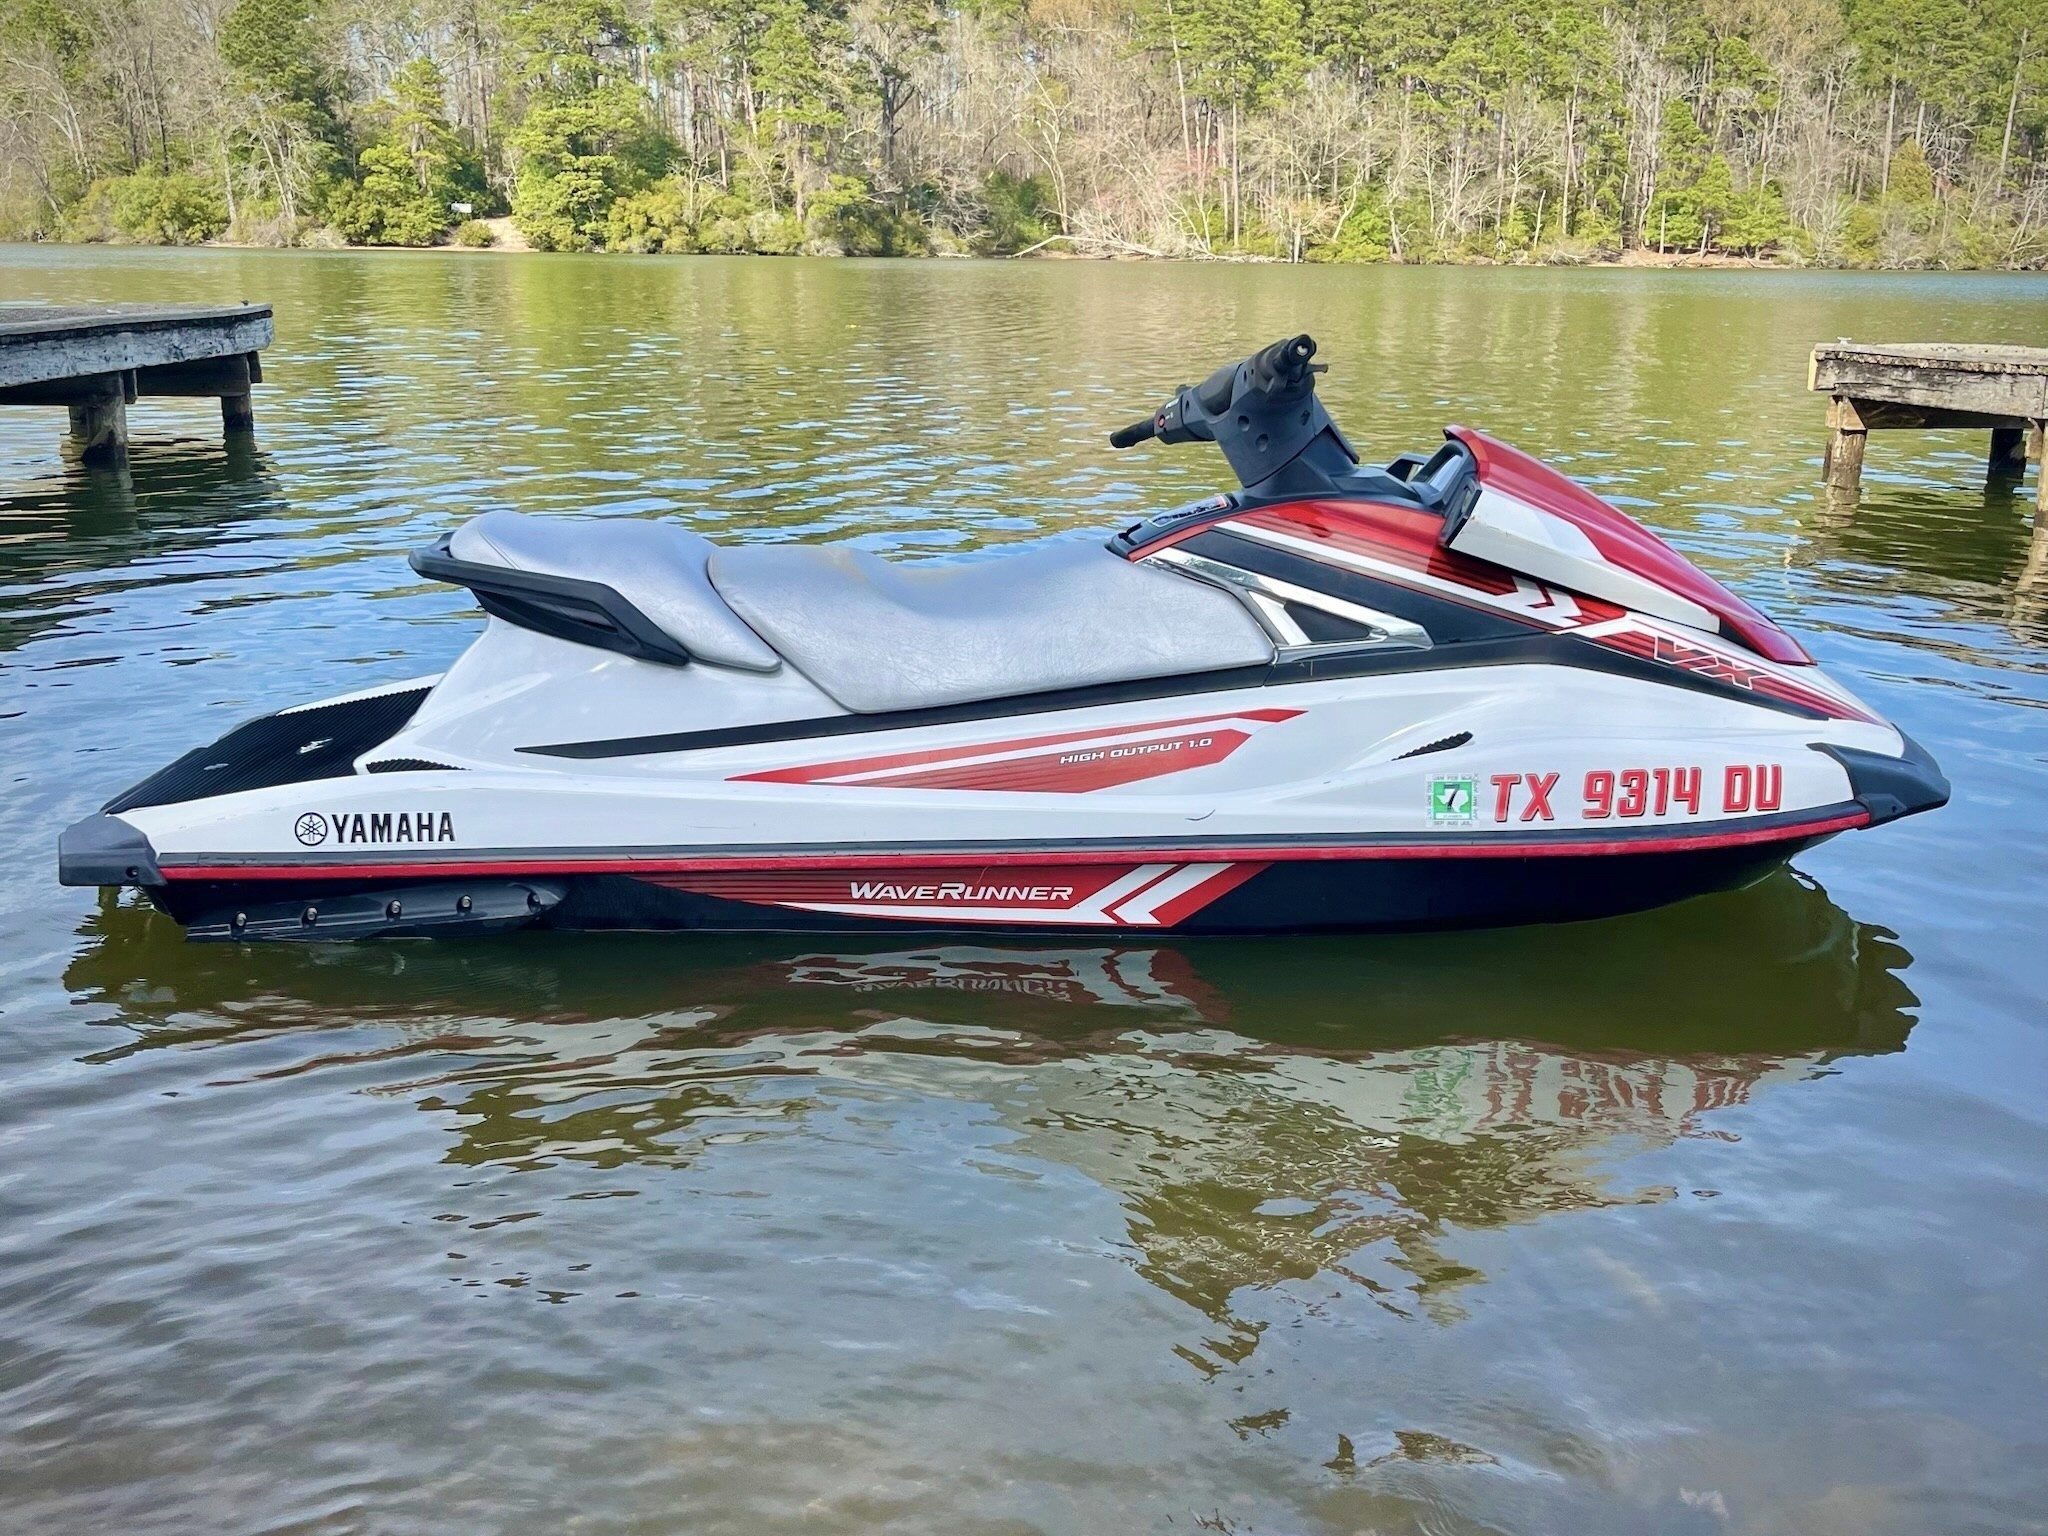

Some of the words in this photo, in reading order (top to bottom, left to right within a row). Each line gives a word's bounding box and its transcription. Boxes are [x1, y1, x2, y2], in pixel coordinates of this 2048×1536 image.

[1653, 635, 1770, 690] VX
[1059, 751, 1105, 764] HIGH
[1109, 741, 1184, 758] OUTPUT
[1188, 737, 1213, 748] 1.0
[1443, 784, 1460, 810] 7
[1490, 772, 1560, 822] TX
[1582, 767, 1702, 819] 9314
[1722, 764, 1783, 812] DU
[331, 812, 456, 843] YAMAHA
